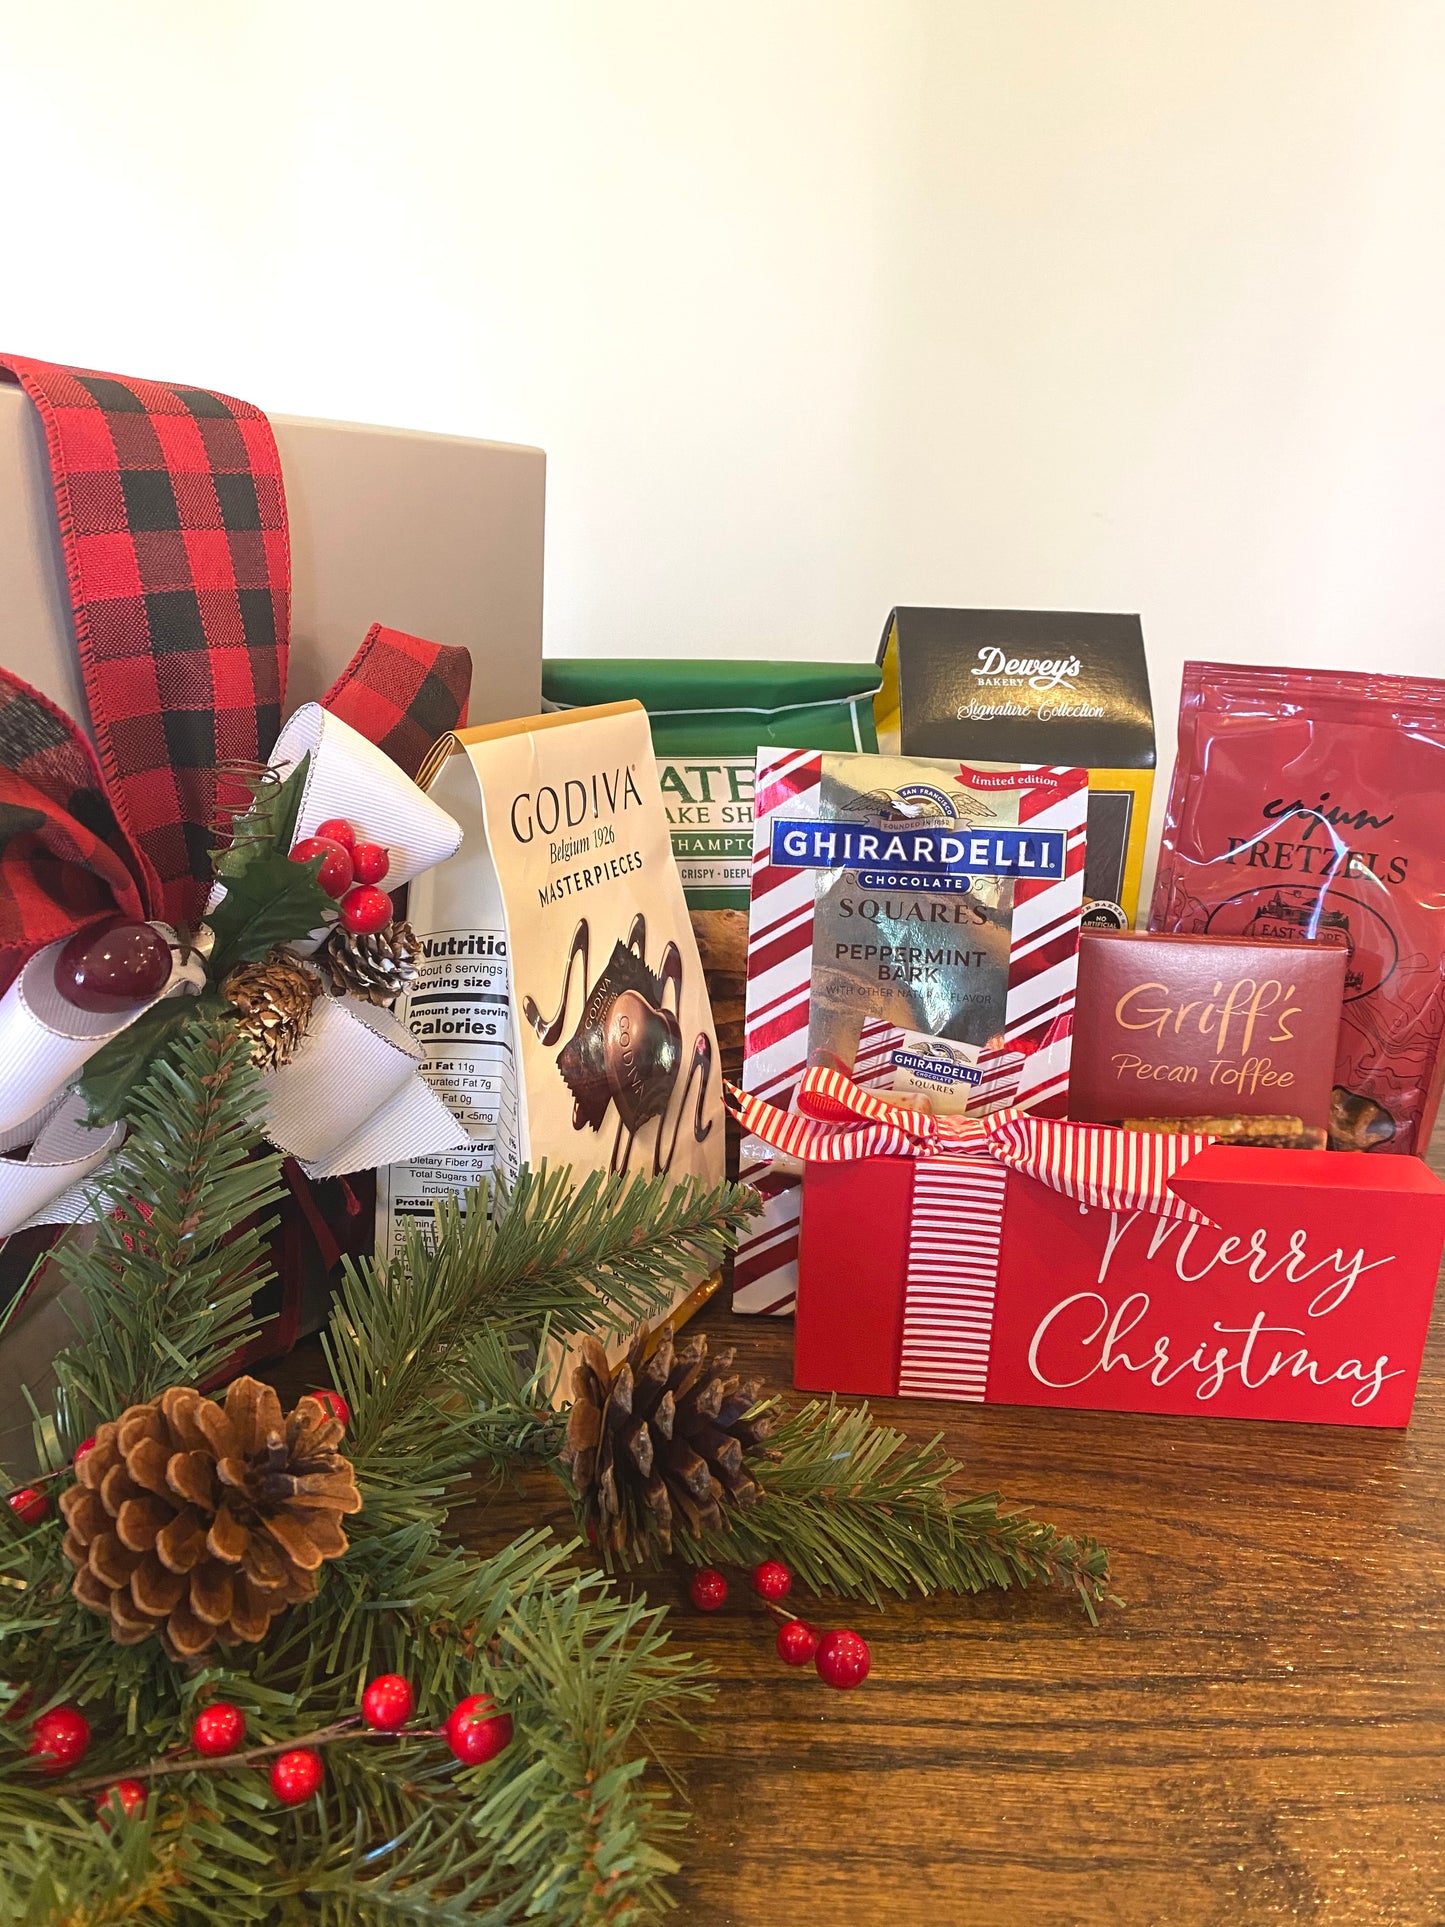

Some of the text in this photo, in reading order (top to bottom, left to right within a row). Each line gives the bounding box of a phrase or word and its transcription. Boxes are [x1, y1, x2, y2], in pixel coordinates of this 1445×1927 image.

[971, 646, 1083, 691] Dewey's
[977, 678, 1024, 687] BAKERY
[957, 698, 1104, 722] Signature Collection
[971, 774, 1058, 787] limited edition
[511, 765, 643, 843] GODIVA
[902, 788, 953, 815] SAN FRANCISCO
[884, 821, 920, 830] FOUNDED
[550, 825, 615, 865] Belgium 1926
[783, 830, 1051, 869] GHIRARDELLI
[1225, 837, 1409, 884] PRETZELS
[538, 851, 643, 908] MASTERPIECES
[681, 868, 714, 879] CRISPY
[864, 875, 963, 889] CHOCOLATE
[838, 898, 988, 926] SQUARES
[1262, 924, 1296, 939] EAST
[835, 943, 987, 968] PEPPERMINT
[445, 963, 452, 973] 6
[455, 963, 503, 978] servings
[878, 964, 939, 983] BARK
[463, 976, 492, 988] size
[584, 976, 612, 1030] GODIVA
[826, 985, 853, 996] WITH
[858, 987, 893, 997] OTHER
[951, 993, 992, 1005] FLAVOR
[409, 1006, 449, 1018] Amount
[452, 1007, 471, 1018] per
[1115, 978, 1302, 1057] Griff's
[410, 1018, 497, 1036] Calories
[436, 1061, 454, 1070] Fat
[458, 1063, 475, 1074] 11g
[894, 1053, 977, 1083] GHIRARDELLI
[1111, 1053, 1296, 1096] Pecan Toffee
[462, 1078, 478, 1088] Fat
[480, 1079, 492, 1090] 7g
[909, 1078, 954, 1095] SQUARES
[442, 1093, 457, 1103] Fat
[467, 1111, 493, 1123] <5mg
[445, 1157, 469, 1167] Fiber
[471, 1159, 483, 1169] 2g
[409, 1169, 433, 1179] Total
[435, 1170, 467, 1182] Sugars
[1078, 1201, 1396, 1318] Merry
[1028, 1291, 1407, 1408] Christmas
